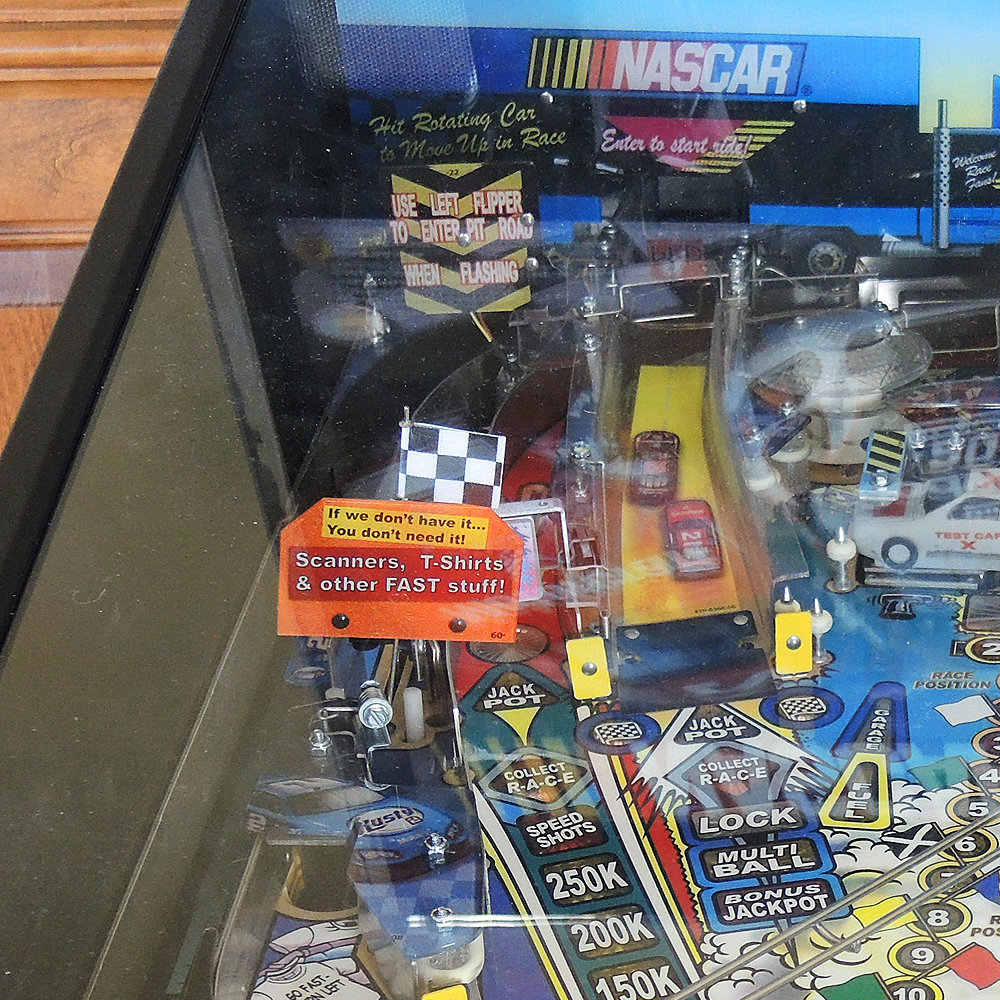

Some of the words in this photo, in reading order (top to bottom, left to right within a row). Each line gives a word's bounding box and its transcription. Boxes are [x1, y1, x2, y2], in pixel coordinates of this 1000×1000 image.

[612, 41, 793, 94] NASCAR
[369, 116, 406, 137] Hit
[412, 105, 492, 136] Rotating
[499, 102, 536, 128] Car
[400, 139, 454, 159] Move
[456, 133, 489, 157] Up
[496, 132, 514, 150] in
[520, 129, 567, 148] Race
[600, 130, 646, 153] Enter
[648, 135, 666, 153] to
[670, 134, 709, 154] start
[712, 134, 753, 155] ride!
[952, 147, 998, 169] Welcome
[965, 163, 992, 179] Race
[965, 174, 997, 193] Fans!
[391, 193, 418, 218] USE
[430, 192, 459, 216] LEFT
[473, 190, 523, 215] FLIPPER
[390, 220, 408, 244] TO
[421, 219, 460, 243] ENTER
[467, 218, 486, 241] PIT
[500, 216, 533, 240] ROAD
[404, 263, 441, 287] WHEN
[460, 260, 519, 285] FLASHING
[328, 507, 341, 520] If
[344, 511, 369, 523] we
[374, 509, 416, 525] don't
[418, 513, 457, 529] have
[460, 516, 487, 531] it...
[328, 524, 357, 538] You
[360, 526, 401, 541] don't
[404, 530, 444, 544] need
[449, 533, 466, 546] it!
[935, 532, 970, 540] TEST
[295, 552, 406, 573] Scanners,
[420, 553, 505, 572] T-Shirts
[295, 576, 312, 592] &
[320, 576, 379, 593] other
[385, 577, 441, 593] FAST
[448, 577, 506, 594] stuff!
[913, 681, 992, 691] POSITION
[930, 671, 975, 681] RACE
[483, 693, 546, 709] POT
[487, 683, 537, 699] JACK
[688, 715, 738, 730] JACK
[865, 709, 890, 751] GARAGE
[684, 726, 748, 741] POT
[504, 761, 566, 781] COLLECT
[698, 757, 760, 773] COLLECT
[507, 771, 575, 793] R-A-C-E
[699, 767, 767, 785] R-A-C-E
[980, 769, 1000, 783] 4
[844, 783, 871, 818] FUEL
[968, 802, 990, 817] 5
[525, 811, 584, 838] SPEED
[698, 808, 797, 833] LOCK
[537, 820, 597, 849] SHOTS
[955, 836, 977, 852] 6
[716, 844, 797, 863] MULTI
[712, 857, 816, 877] BALL
[545, 861, 629, 900] 250K
[723, 884, 822, 905] BONUS
[722, 893, 828, 920] JACKPOT
[926, 909, 951, 926] 8
[570, 912, 656, 953] 200K
[910, 948, 936, 965] 9
[323, 979, 346, 997] LEFT
